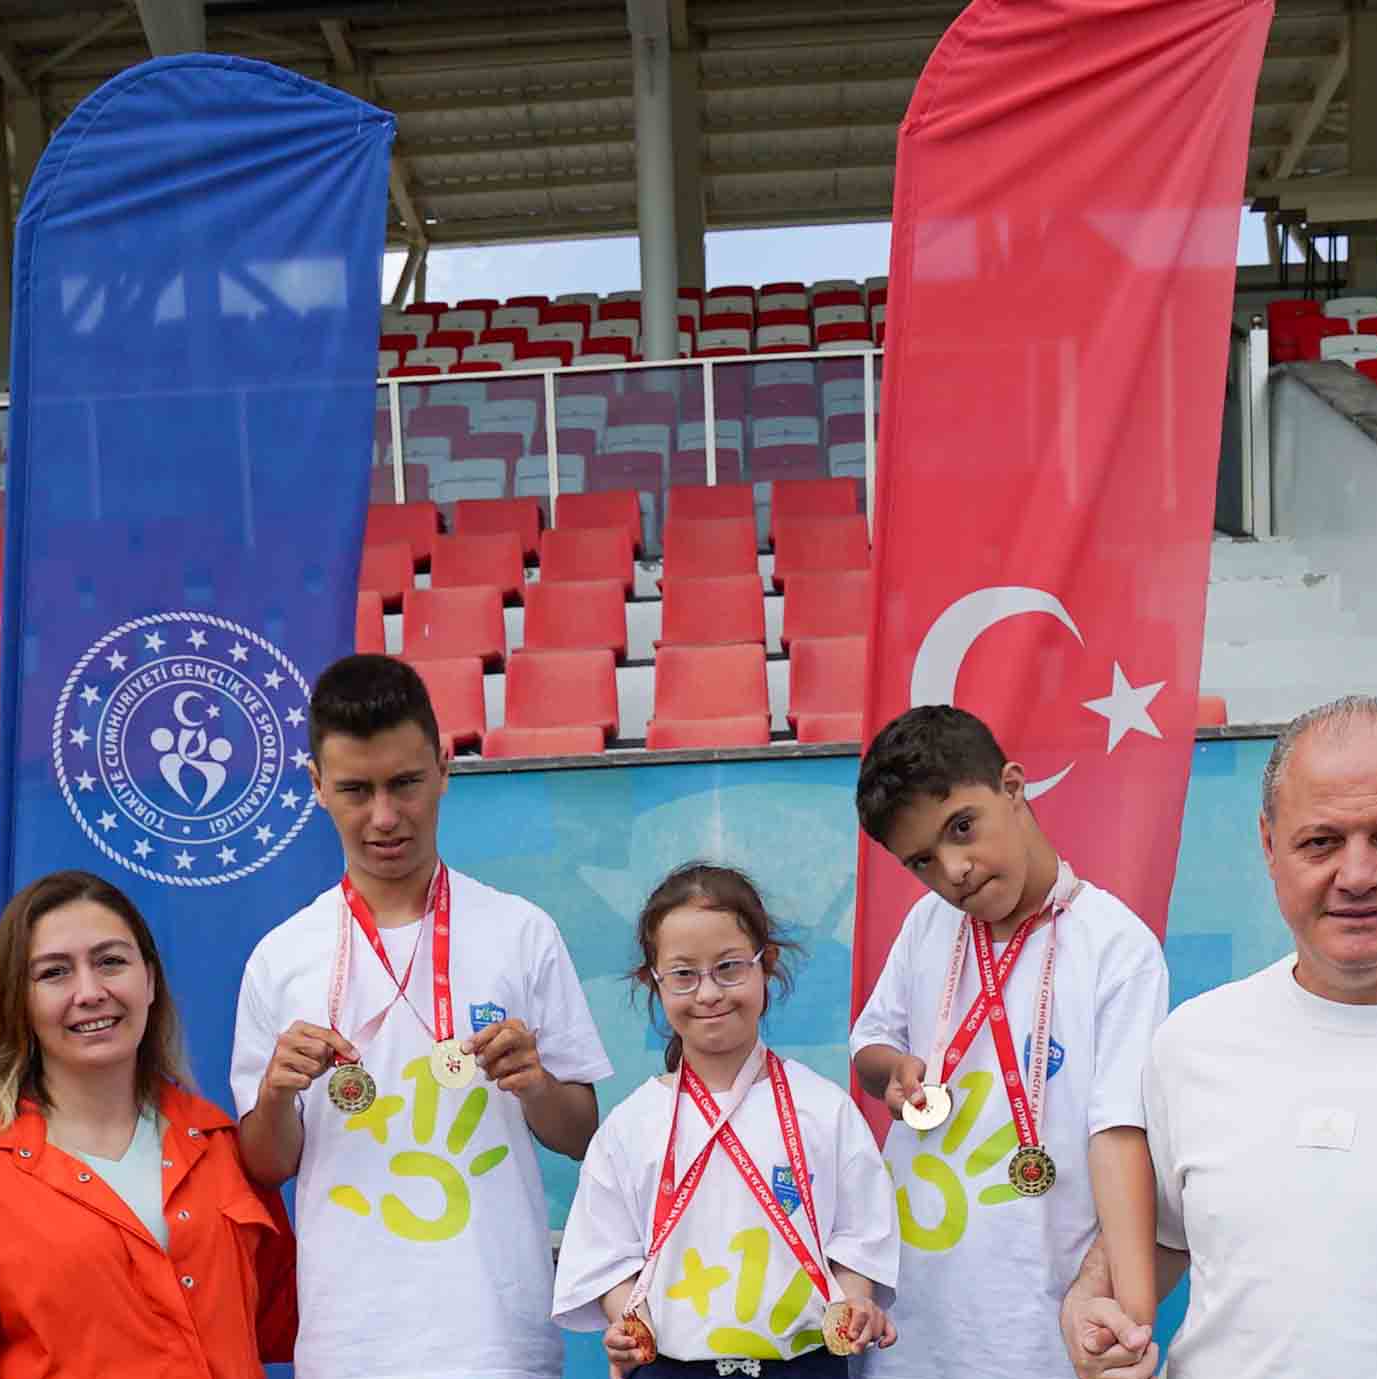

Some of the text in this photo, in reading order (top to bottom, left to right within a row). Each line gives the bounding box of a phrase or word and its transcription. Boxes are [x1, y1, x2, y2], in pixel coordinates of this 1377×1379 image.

[105, 664, 277, 833] TÜRKİYE CUMHURİYETİ GENÇLİK VE SPOR BAKANLIĞI
